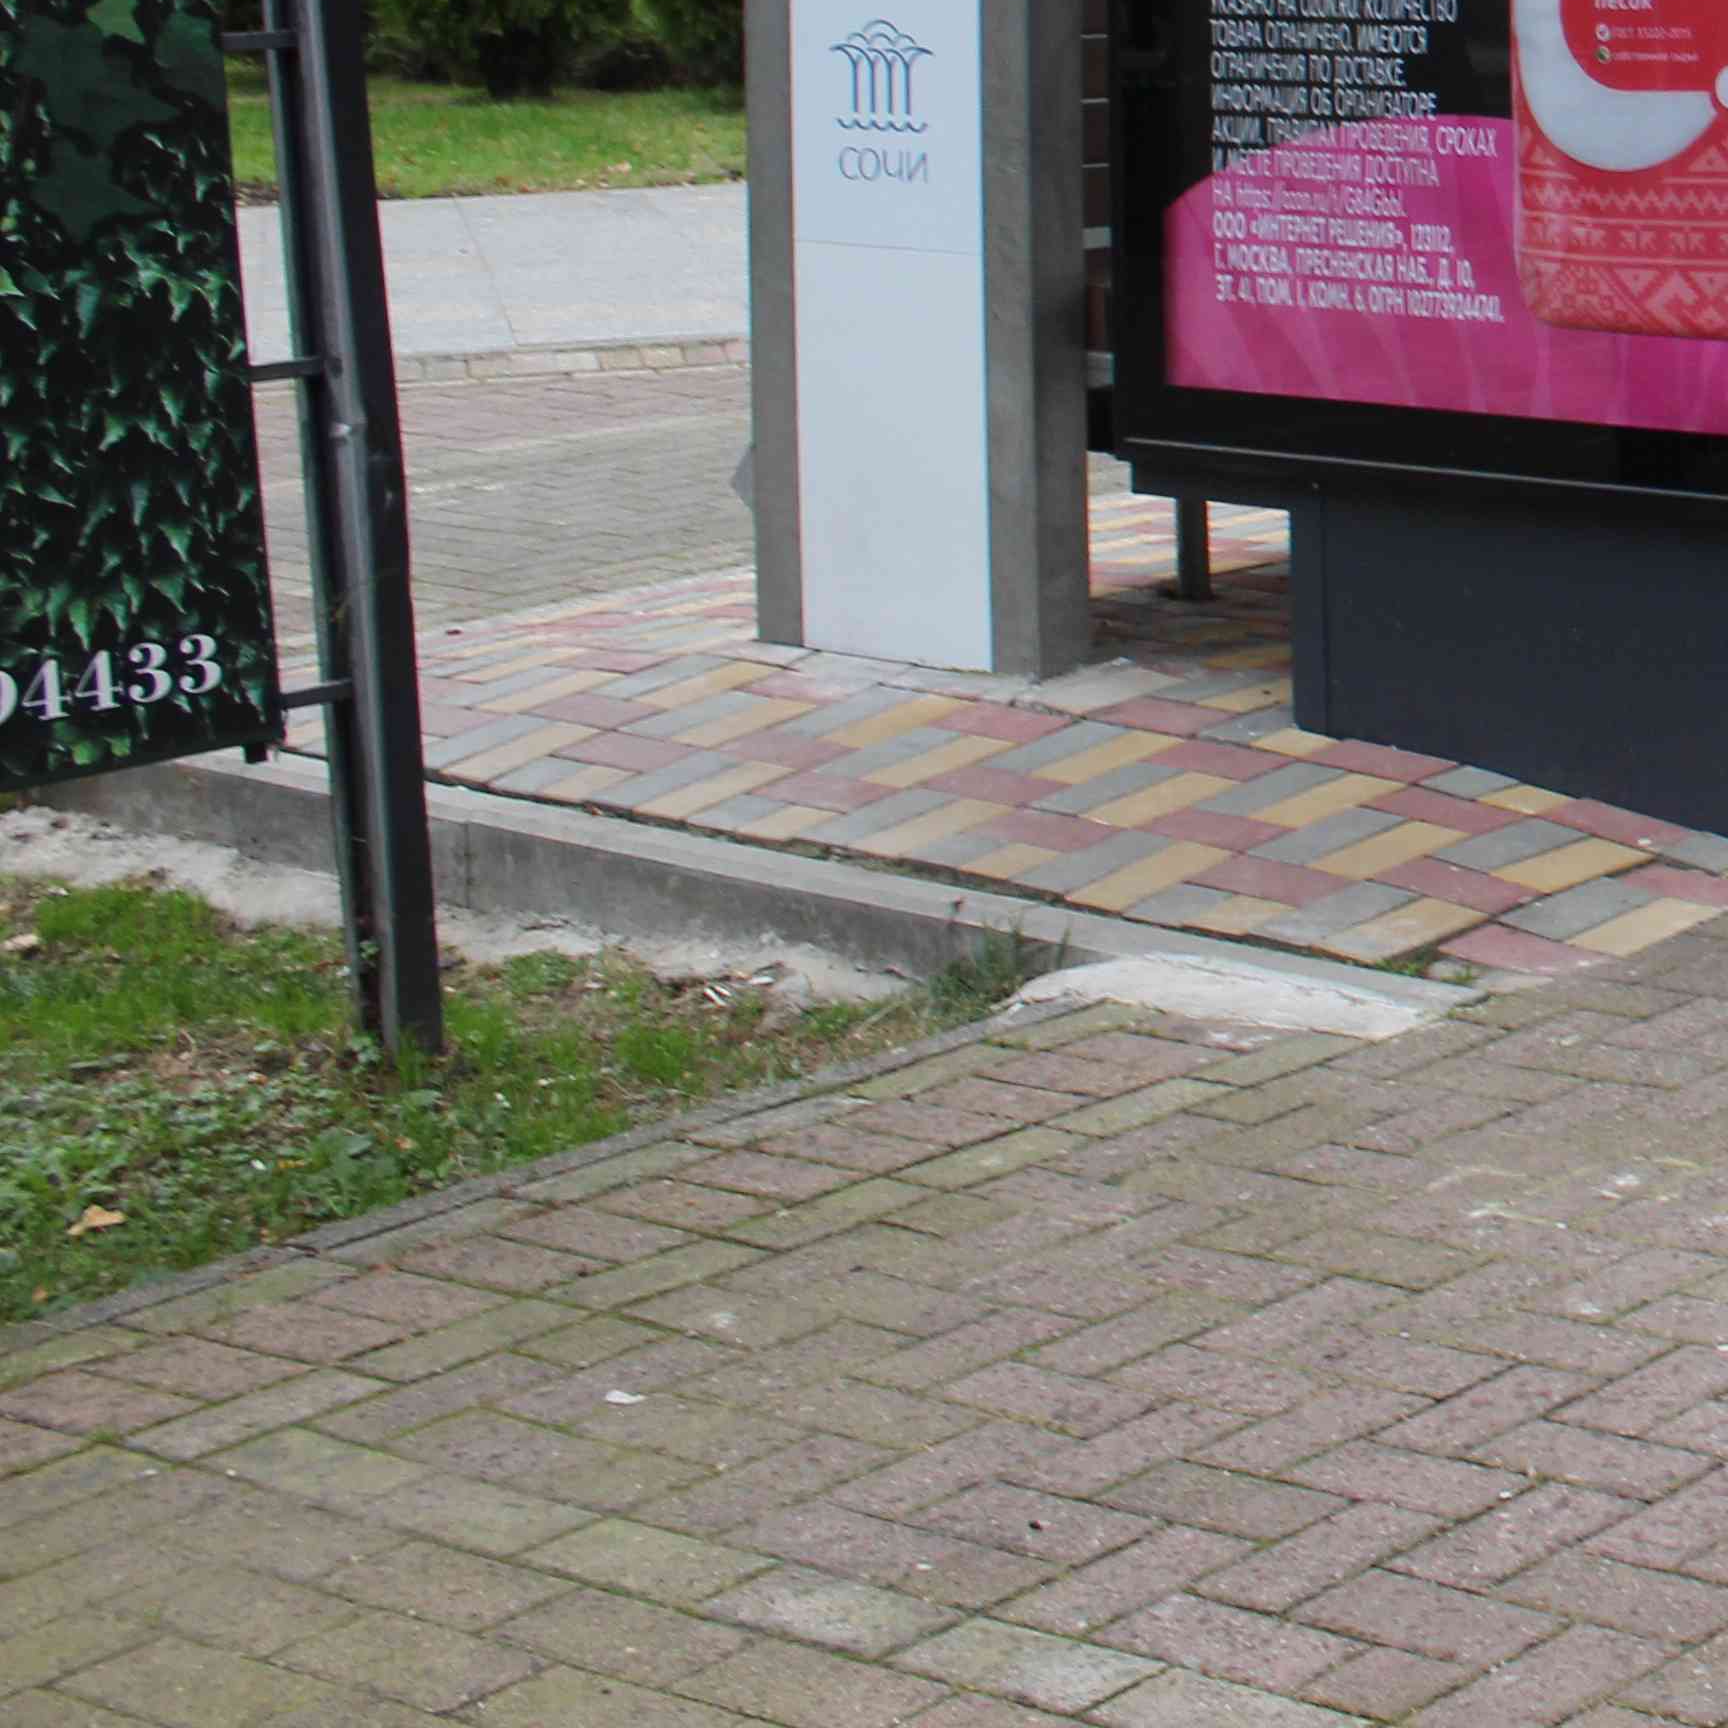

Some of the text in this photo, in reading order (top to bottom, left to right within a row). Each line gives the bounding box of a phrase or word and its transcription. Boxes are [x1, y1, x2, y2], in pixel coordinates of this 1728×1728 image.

[1209, 19, 1263, 49] ТОВАРА
[1355, 24, 1428, 55] ИМЕЮТСЯ
[1210, 52, 1306, 80] ОГРАНИЧЕНИЯ
[1309, 55, 1332, 83] ПО
[1211, 83, 1438, 121] ИНФОРМАЦИЯ ОБ ОРГАНИЗАТОРЕ
[1436, 126, 1499, 158] СРОКАХ
[838, 147, 929, 184] СОЧИ
[1274, 150, 1361, 182] ПРОВЕДЕНИЯ
[1364, 155, 1440, 188] ДОСТУПНА
[1213, 210, 1247, 241] ООО
